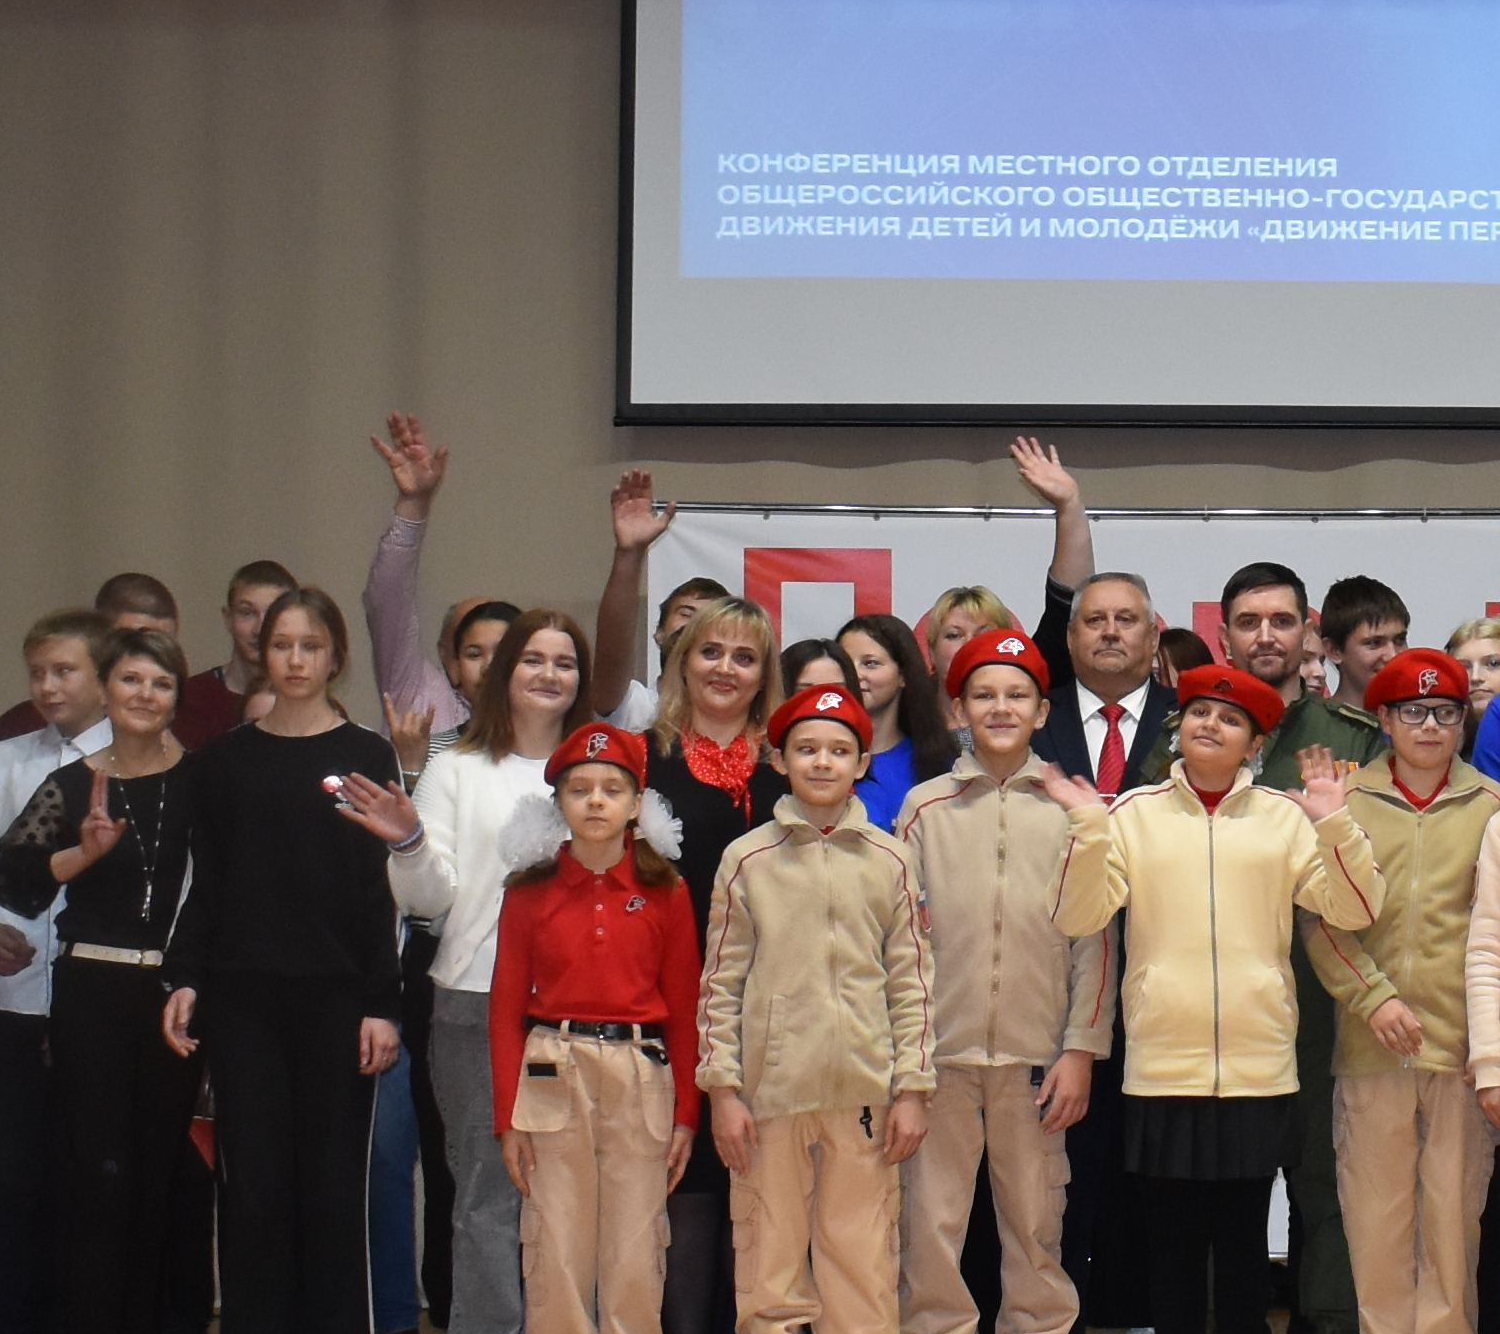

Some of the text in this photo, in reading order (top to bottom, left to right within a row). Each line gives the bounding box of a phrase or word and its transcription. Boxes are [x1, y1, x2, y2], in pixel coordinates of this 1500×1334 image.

[717, 152, 1338, 179] КОНФЕРЕНЦИЯ МЕСТНОГО ОТДЕЛЕНИЯ
[716, 181, 1056, 207] ОБЩЕРОССИЙСКОГО
[715, 215, 901, 239] ДВИЖЕНИЯ
[906, 212, 1013, 240] ДЕТЕЙ
[1019, 217, 1041, 237] И
[1048, 214, 1240, 242] МОЛОДЁЖИ
[1246, 219, 1443, 244] «ДВИЖЕНИЕ
